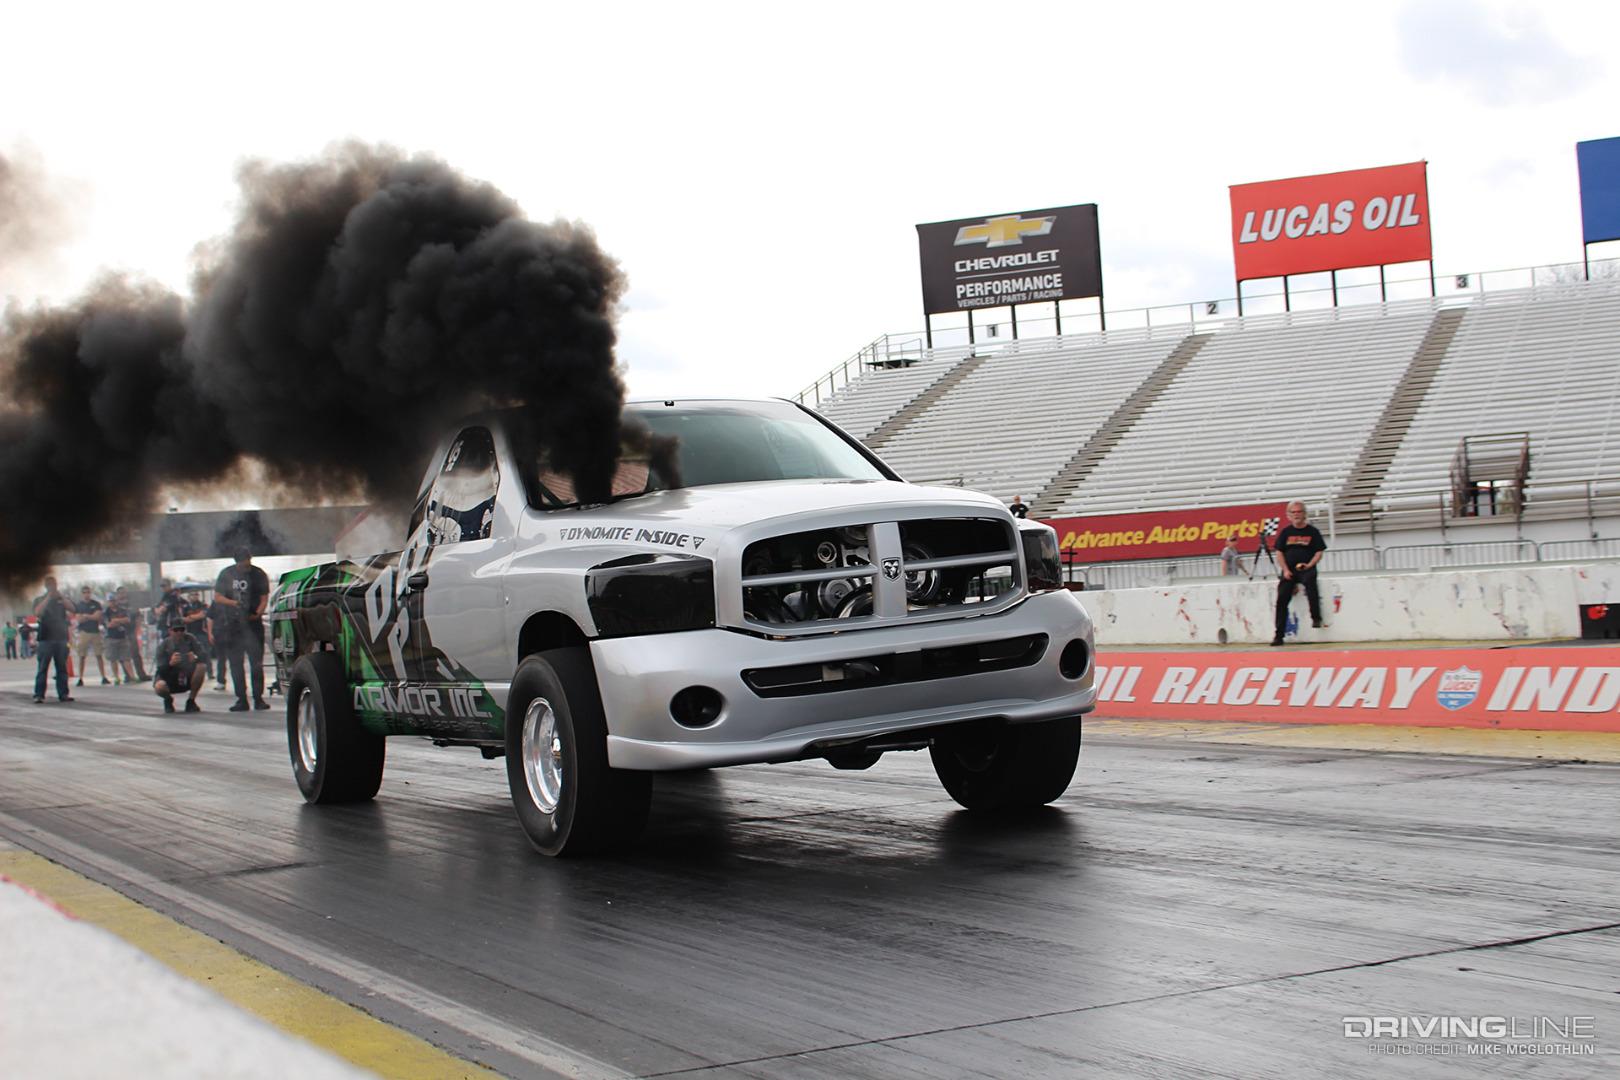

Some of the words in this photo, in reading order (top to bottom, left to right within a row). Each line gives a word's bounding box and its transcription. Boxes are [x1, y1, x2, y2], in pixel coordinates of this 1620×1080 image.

[1239, 199, 1356, 244] LUCAS
[1362, 193, 1421, 231] OIL
[955, 249, 1060, 273] CHEVROLET
[956, 273, 1063, 299] PERFORMANCE
[1458, 276, 1467, 288] 3
[957, 294, 995, 308] VEHICLES
[1002, 292, 1027, 304] PARTS
[1033, 289, 1063, 300] RACING
[1208, 303, 1217, 315] 2
[567, 526, 634, 541] DYNOMITE
[635, 528, 689, 547] INSIDE
[1060, 530, 1144, 549] Advance
[1145, 524, 1200, 545] Auto
[1151, 666, 1439, 709] RACEWAY
[1485, 667, 1620, 714] IND
[353, 686, 446, 717] ARMOR
